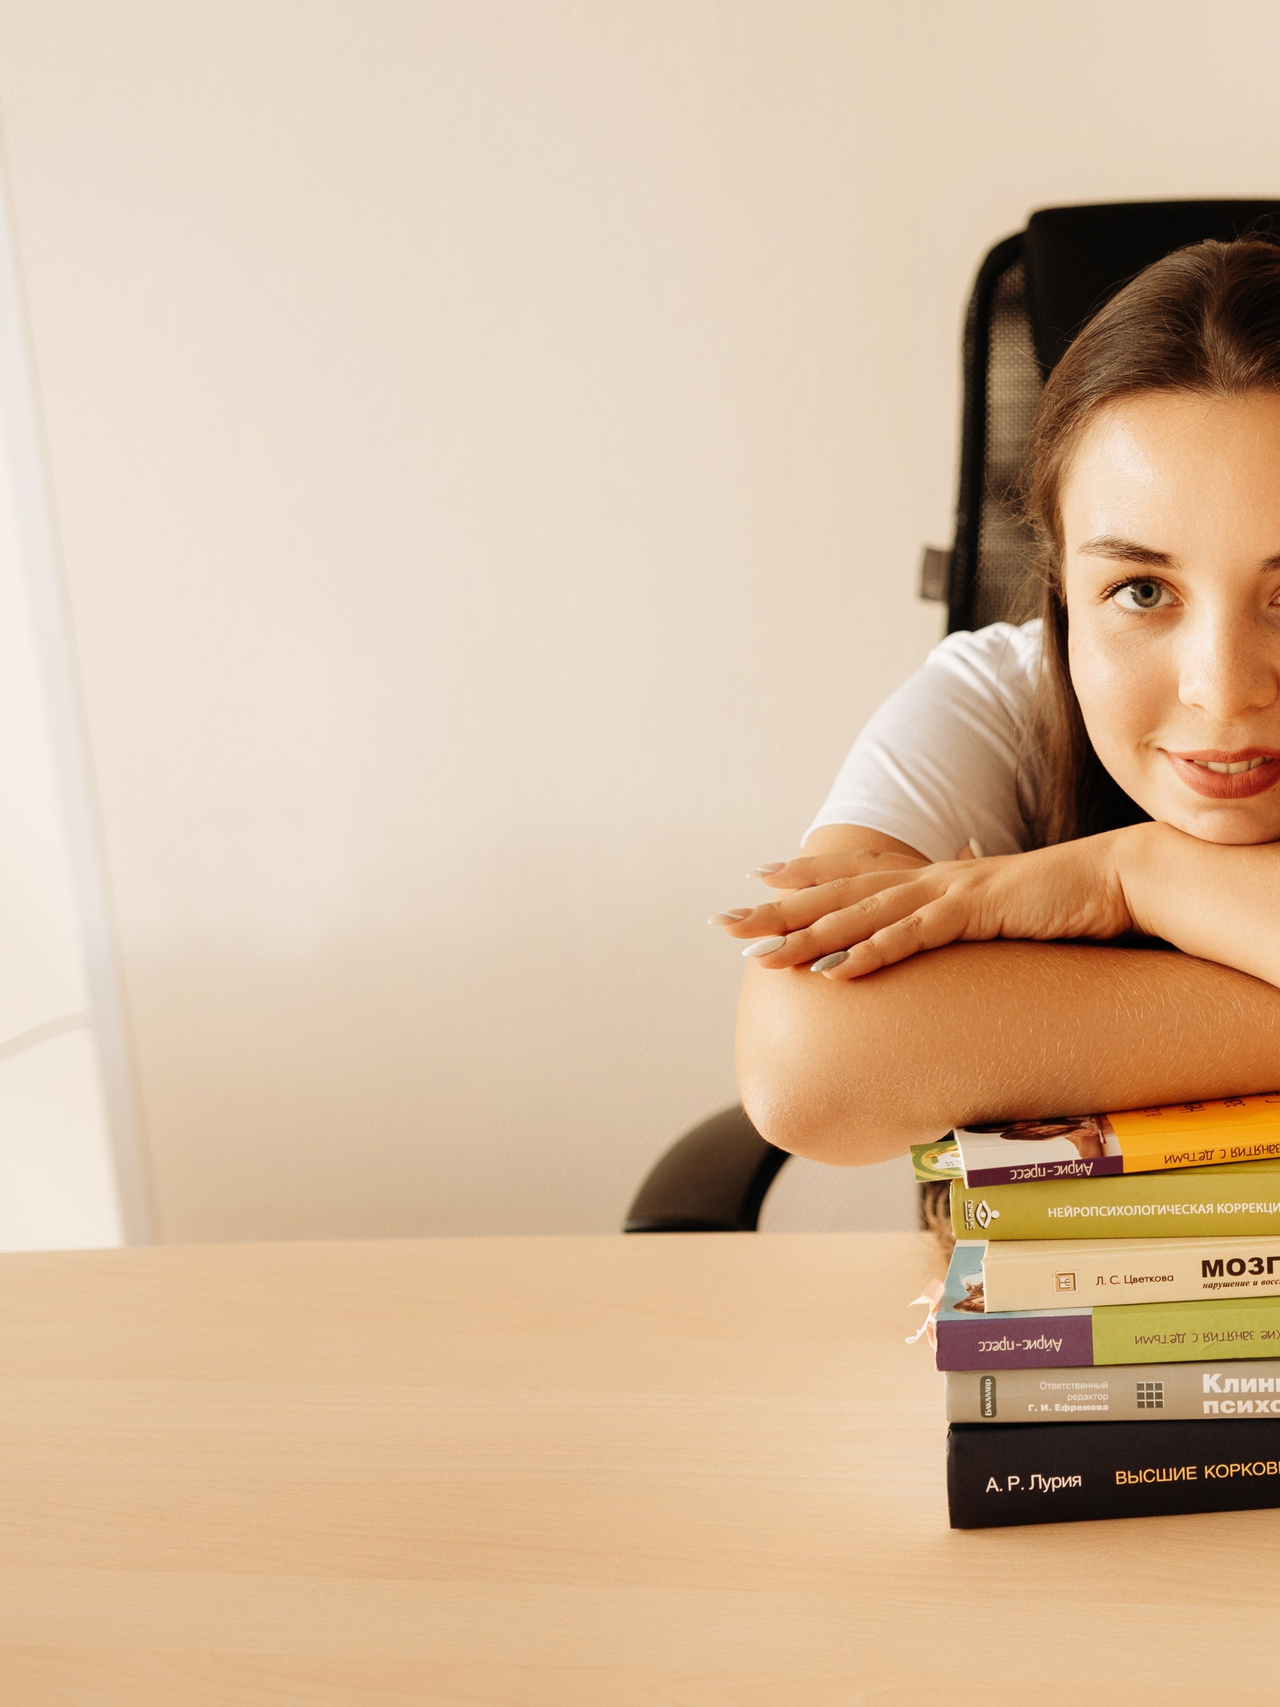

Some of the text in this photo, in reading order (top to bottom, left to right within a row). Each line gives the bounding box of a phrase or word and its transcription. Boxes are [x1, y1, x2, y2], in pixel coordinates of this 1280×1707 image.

[1164, 1147, 1213, 1164] детьми
[1220, 1149, 1228, 1159] с
[1231, 1142, 1280, 1158] занятия
[1010, 1161, 1093, 1180] Айрис-пресс
[1048, 1202, 1213, 1218] НЕЙРОПСИХОЛОГИЧЕСКАЯ
[1096, 1272, 1174, 1286] Л. С. Цветкова
[1202, 1280, 1250, 1290] нарушение
[1135, 1330, 1185, 1344] детьми
[1192, 1332, 1198, 1342] с
[1202, 1329, 1254, 1342] занятия
[979, 1334, 1062, 1352] Айрис-пресс
[1039, 1381, 1108, 1390] Ответственный
[1067, 1392, 1108, 1402] редактор
[1028, 1404, 1108, 1414] Г. И. Ефремова
[1116, 1467, 1197, 1485] ВЫСШИЕ
[986, 1474, 1082, 1493] А. Р. Лурия
